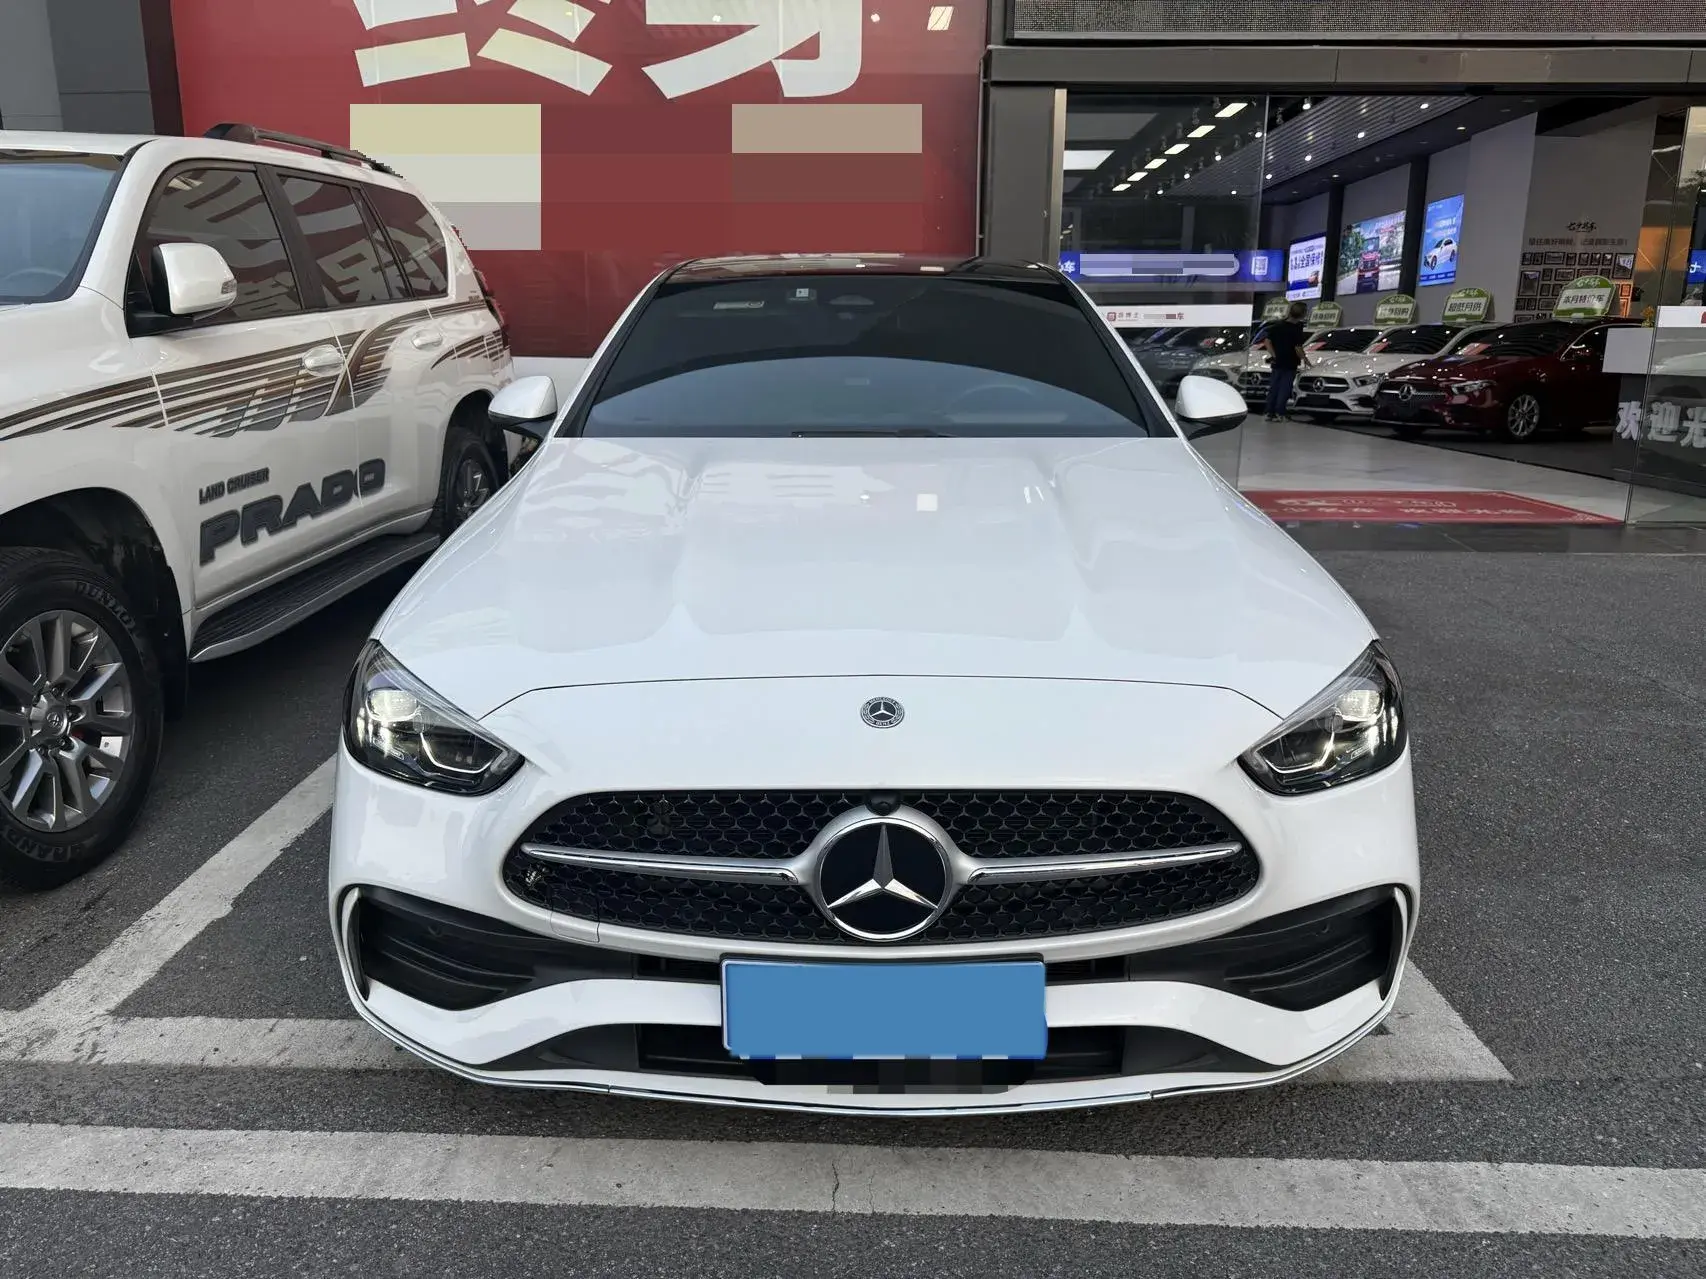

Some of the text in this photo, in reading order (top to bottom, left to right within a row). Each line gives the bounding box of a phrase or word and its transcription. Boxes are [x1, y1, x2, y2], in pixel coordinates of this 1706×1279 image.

[199, 467, 270, 505] LAND CRUISER
[199, 458, 386, 566] PRADO
